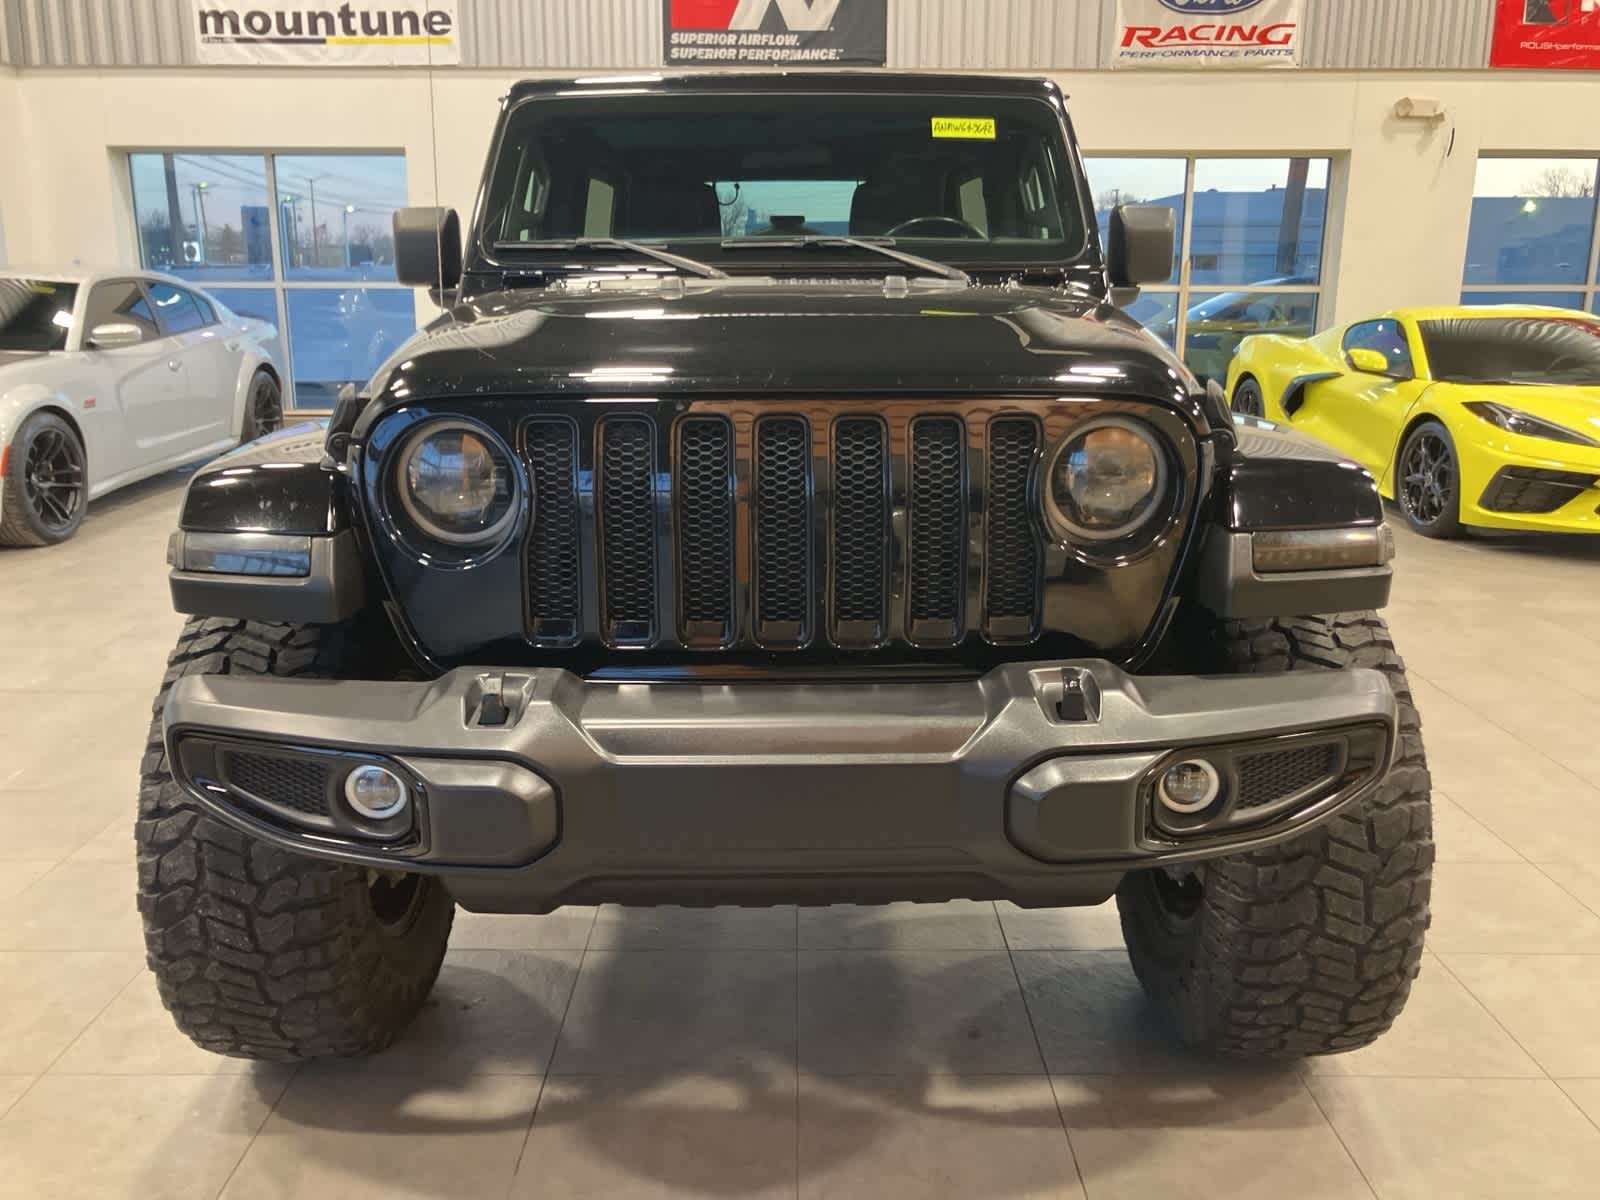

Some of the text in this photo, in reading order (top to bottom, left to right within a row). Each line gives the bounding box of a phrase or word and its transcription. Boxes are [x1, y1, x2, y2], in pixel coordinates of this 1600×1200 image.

[199, 2, 452, 36] mountune
[670, 32, 800, 46] SUPERIOR AIRFLOW.
[1120, 23, 1297, 48] RACING
[670, 48, 737, 60] SUPERIOR
[1119, 48, 1295, 58] PERFORMANCE PARTS
